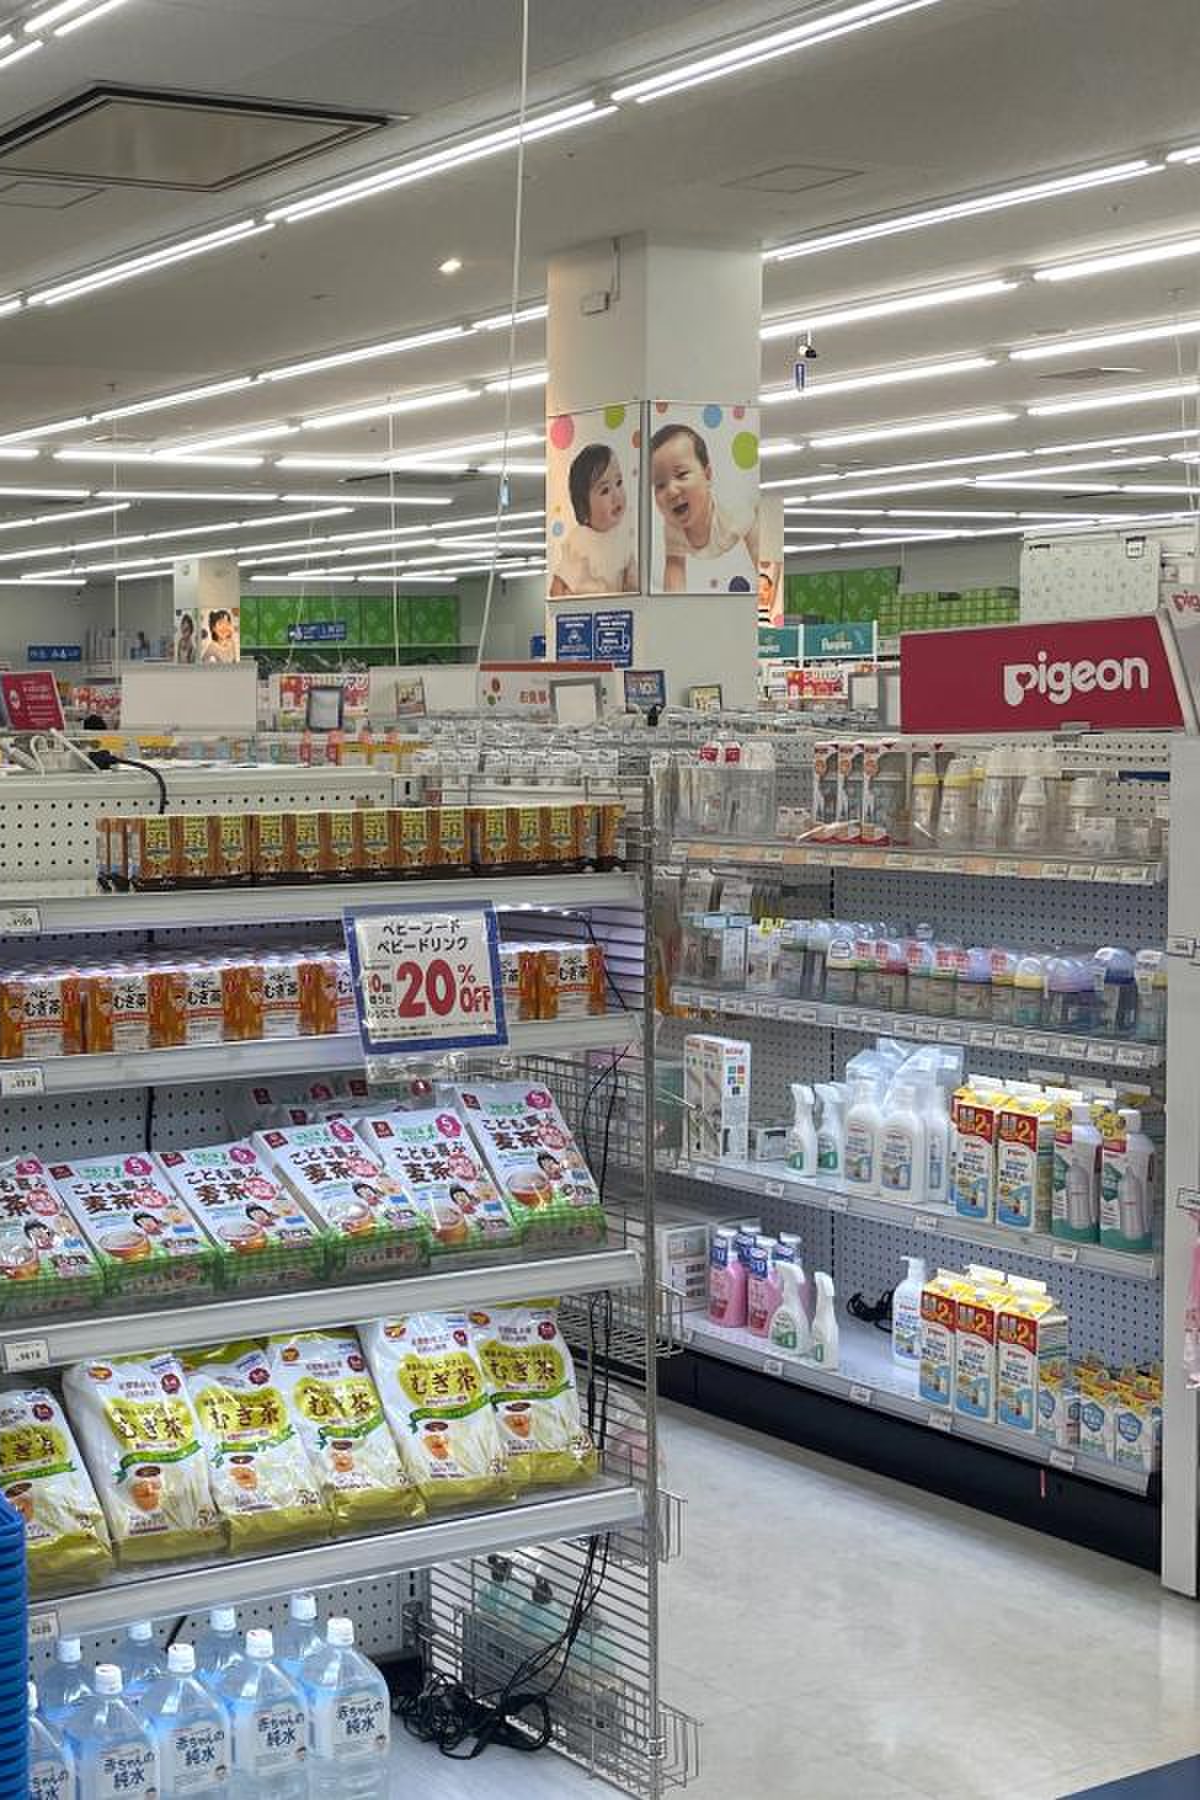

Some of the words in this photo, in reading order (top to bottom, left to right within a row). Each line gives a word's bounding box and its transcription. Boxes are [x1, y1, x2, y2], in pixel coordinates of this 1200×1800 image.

[1003, 650, 1150, 706] pigeon
[383, 918, 462, 936] ベビーフード
[377, 936, 470, 955] ベビードリンク
[459, 985, 492, 1014] OFF
